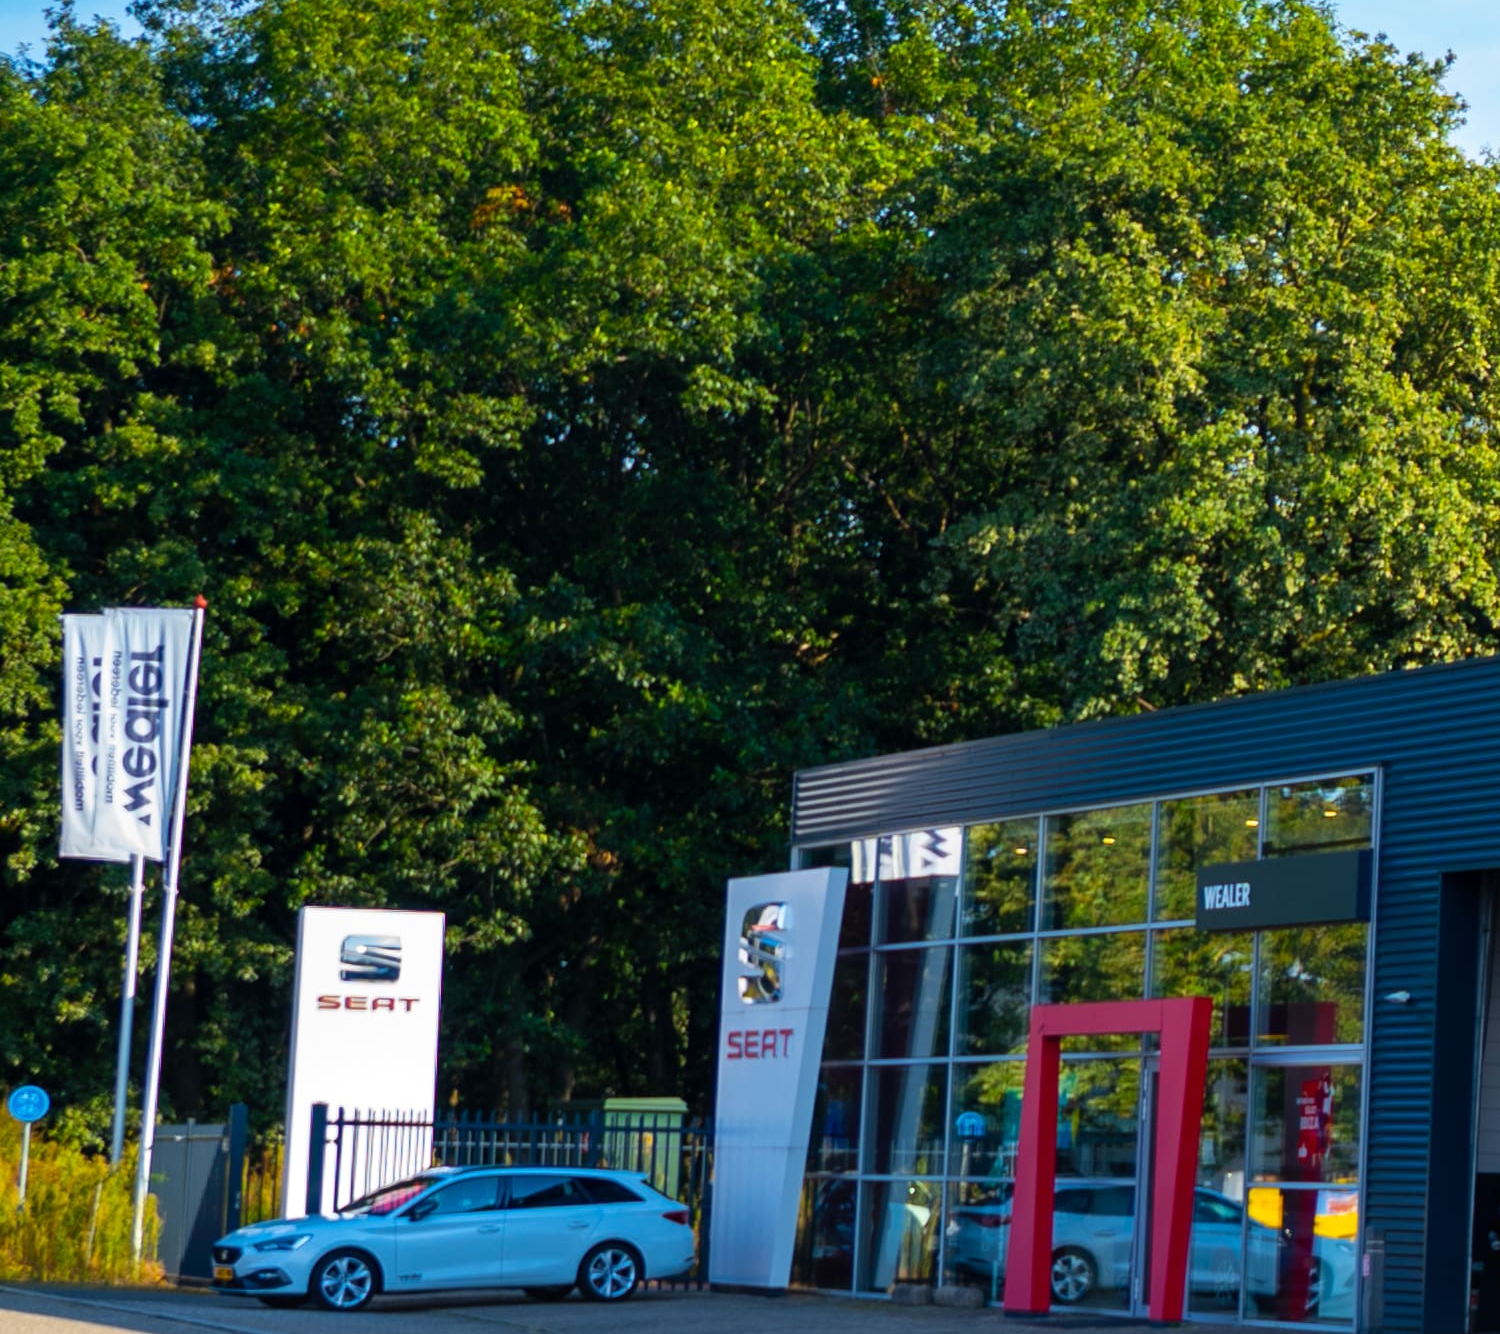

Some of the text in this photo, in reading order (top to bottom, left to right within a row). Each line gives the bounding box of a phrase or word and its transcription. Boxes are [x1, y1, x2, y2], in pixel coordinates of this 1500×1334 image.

[1203, 882, 1250, 910] WEALER
[317, 994, 420, 1012] SEAT
[726, 1028, 794, 1059] SEAT
